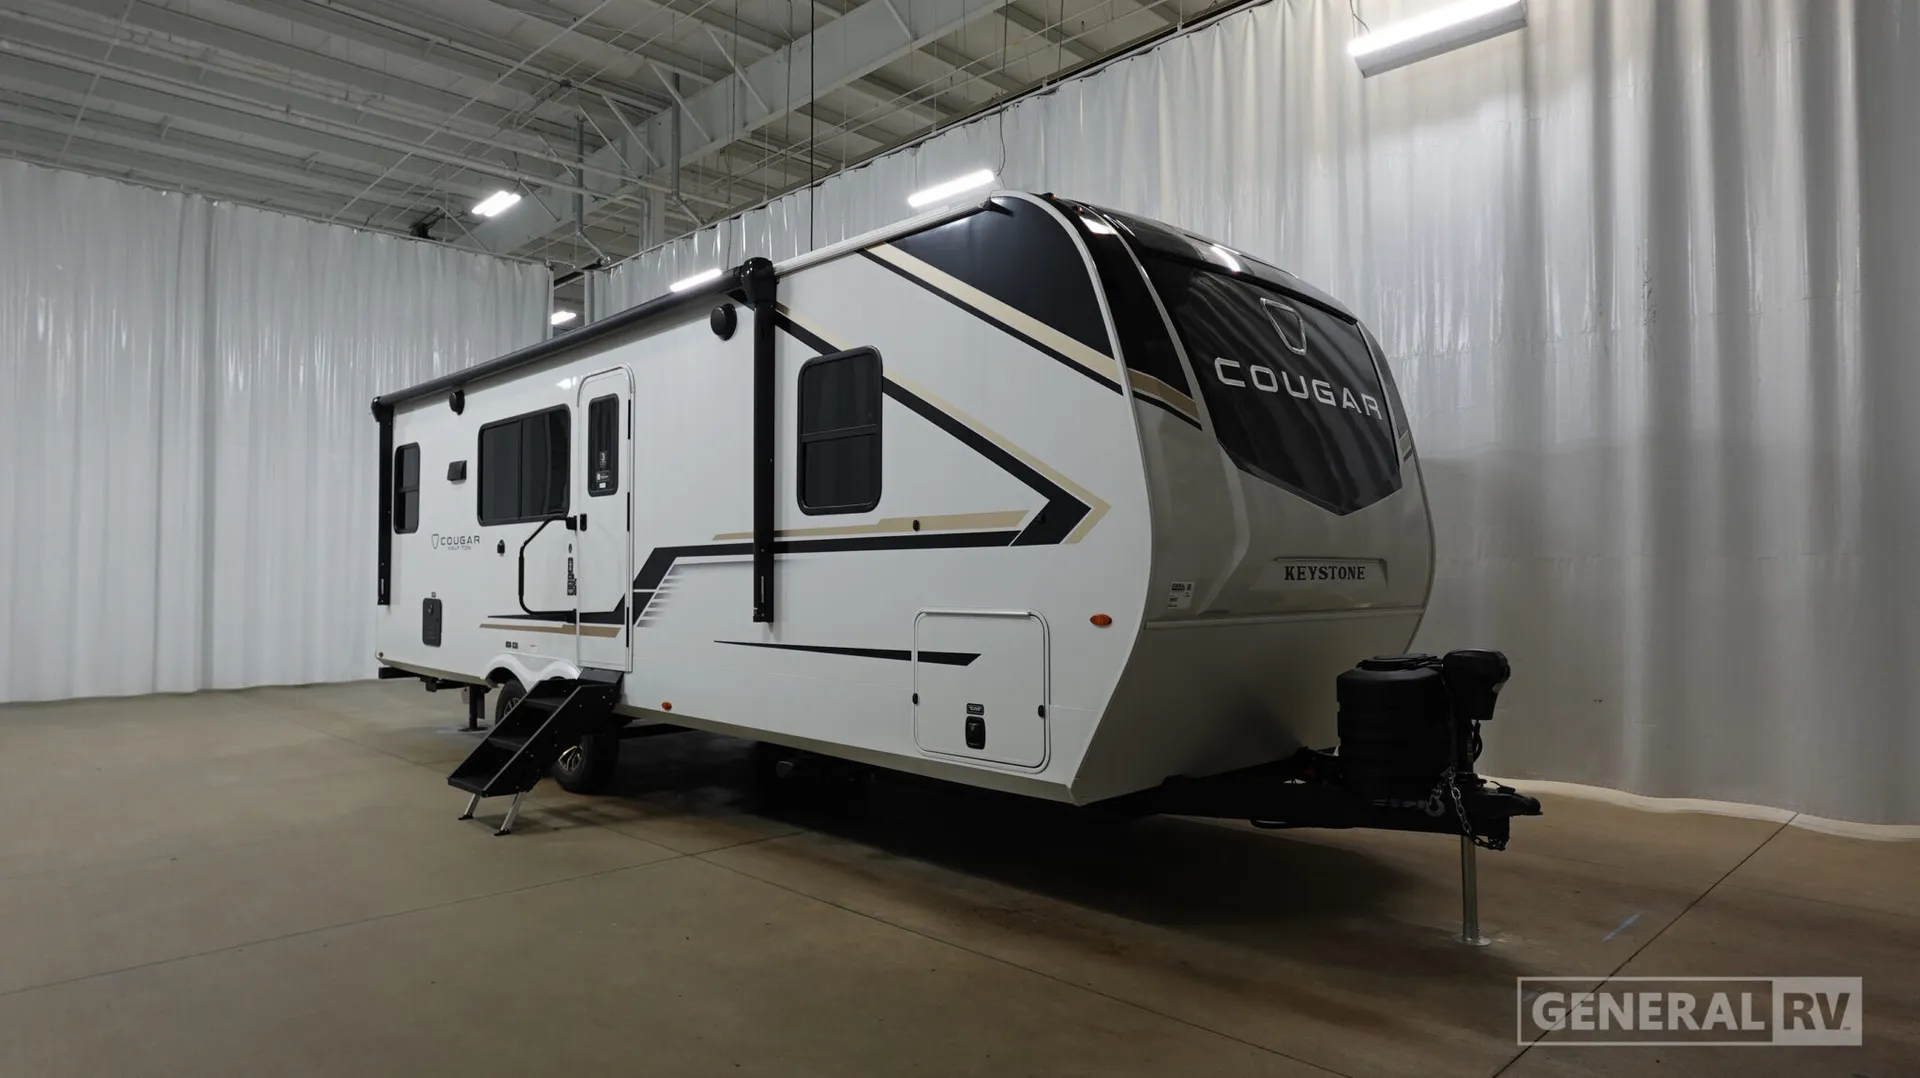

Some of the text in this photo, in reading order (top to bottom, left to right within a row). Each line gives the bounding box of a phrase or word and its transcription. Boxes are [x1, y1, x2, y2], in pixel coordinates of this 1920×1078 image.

[1214, 357, 1382, 420] COUGAR
[440, 535, 480, 545] COUGAR
[1284, 565, 1366, 581] KEYSTONE
